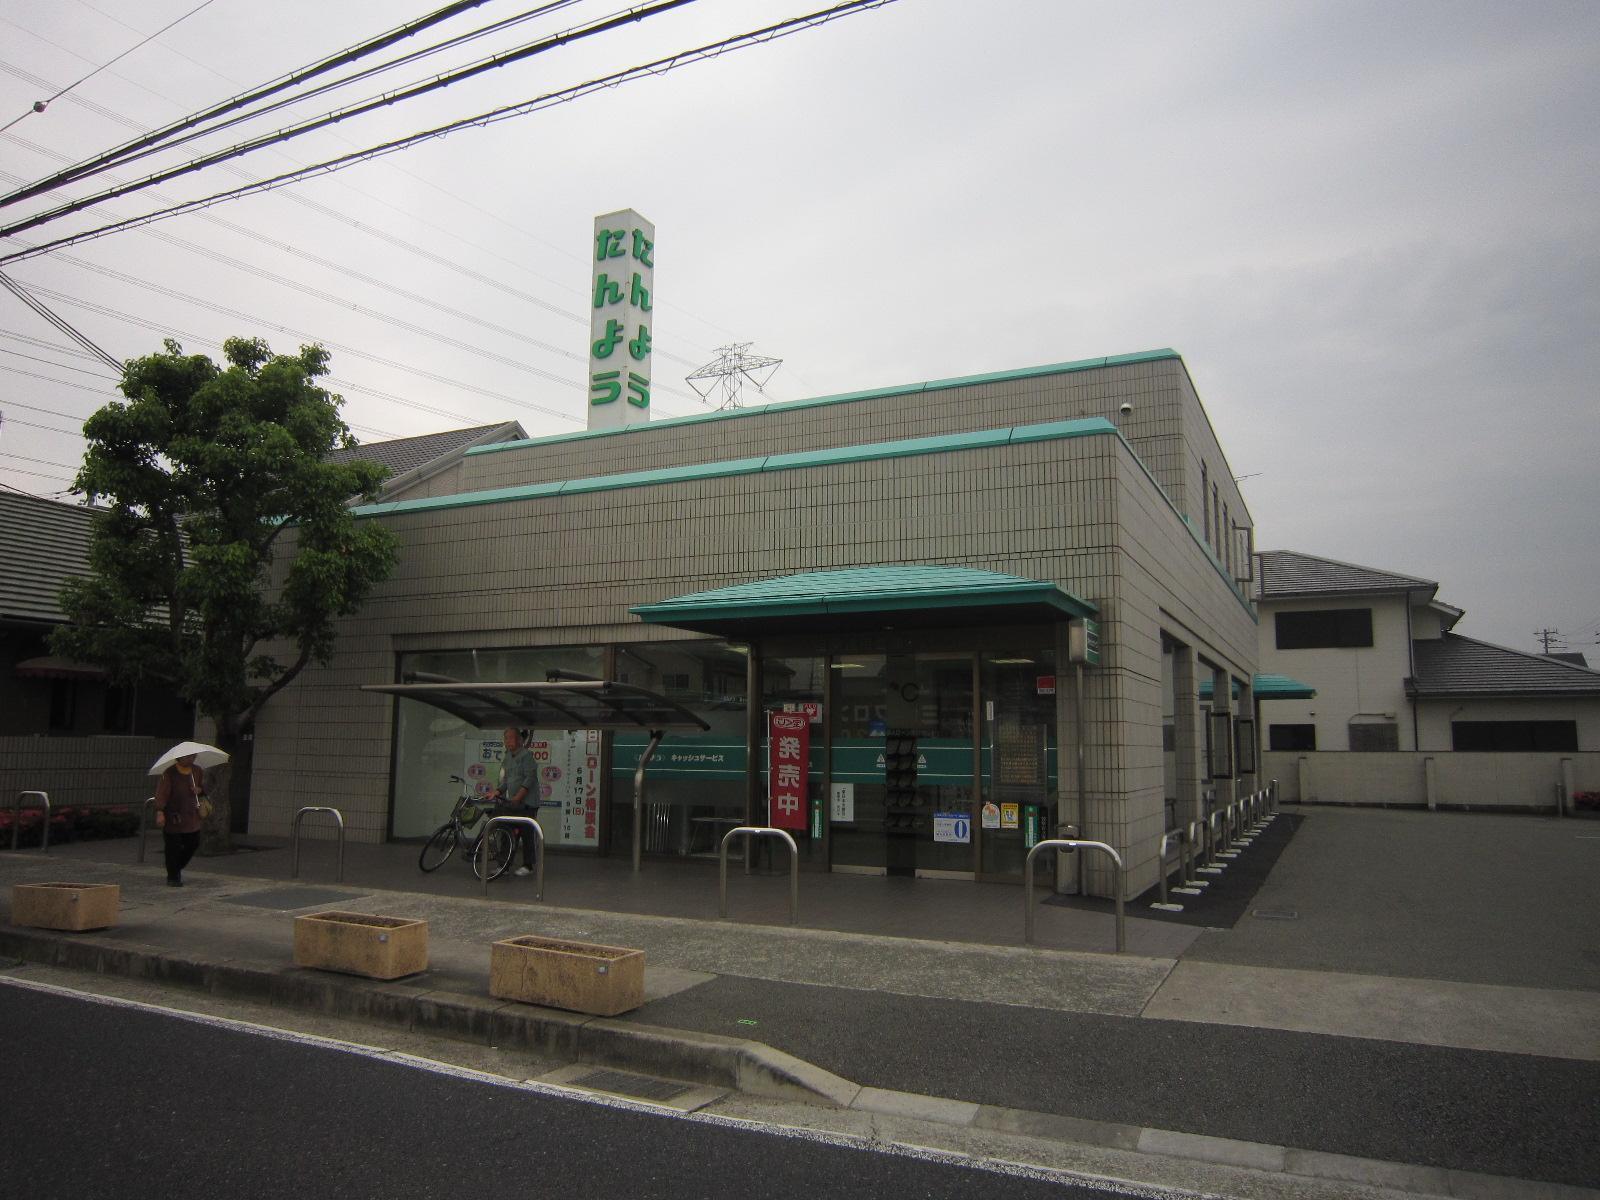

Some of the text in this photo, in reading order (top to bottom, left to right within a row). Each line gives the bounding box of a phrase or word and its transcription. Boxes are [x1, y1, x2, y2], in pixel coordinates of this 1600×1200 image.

[591, 228, 626, 406] たんよう
[627, 228, 654, 409] たんよう
[671, 753, 725, 763] キャッシュサービス
